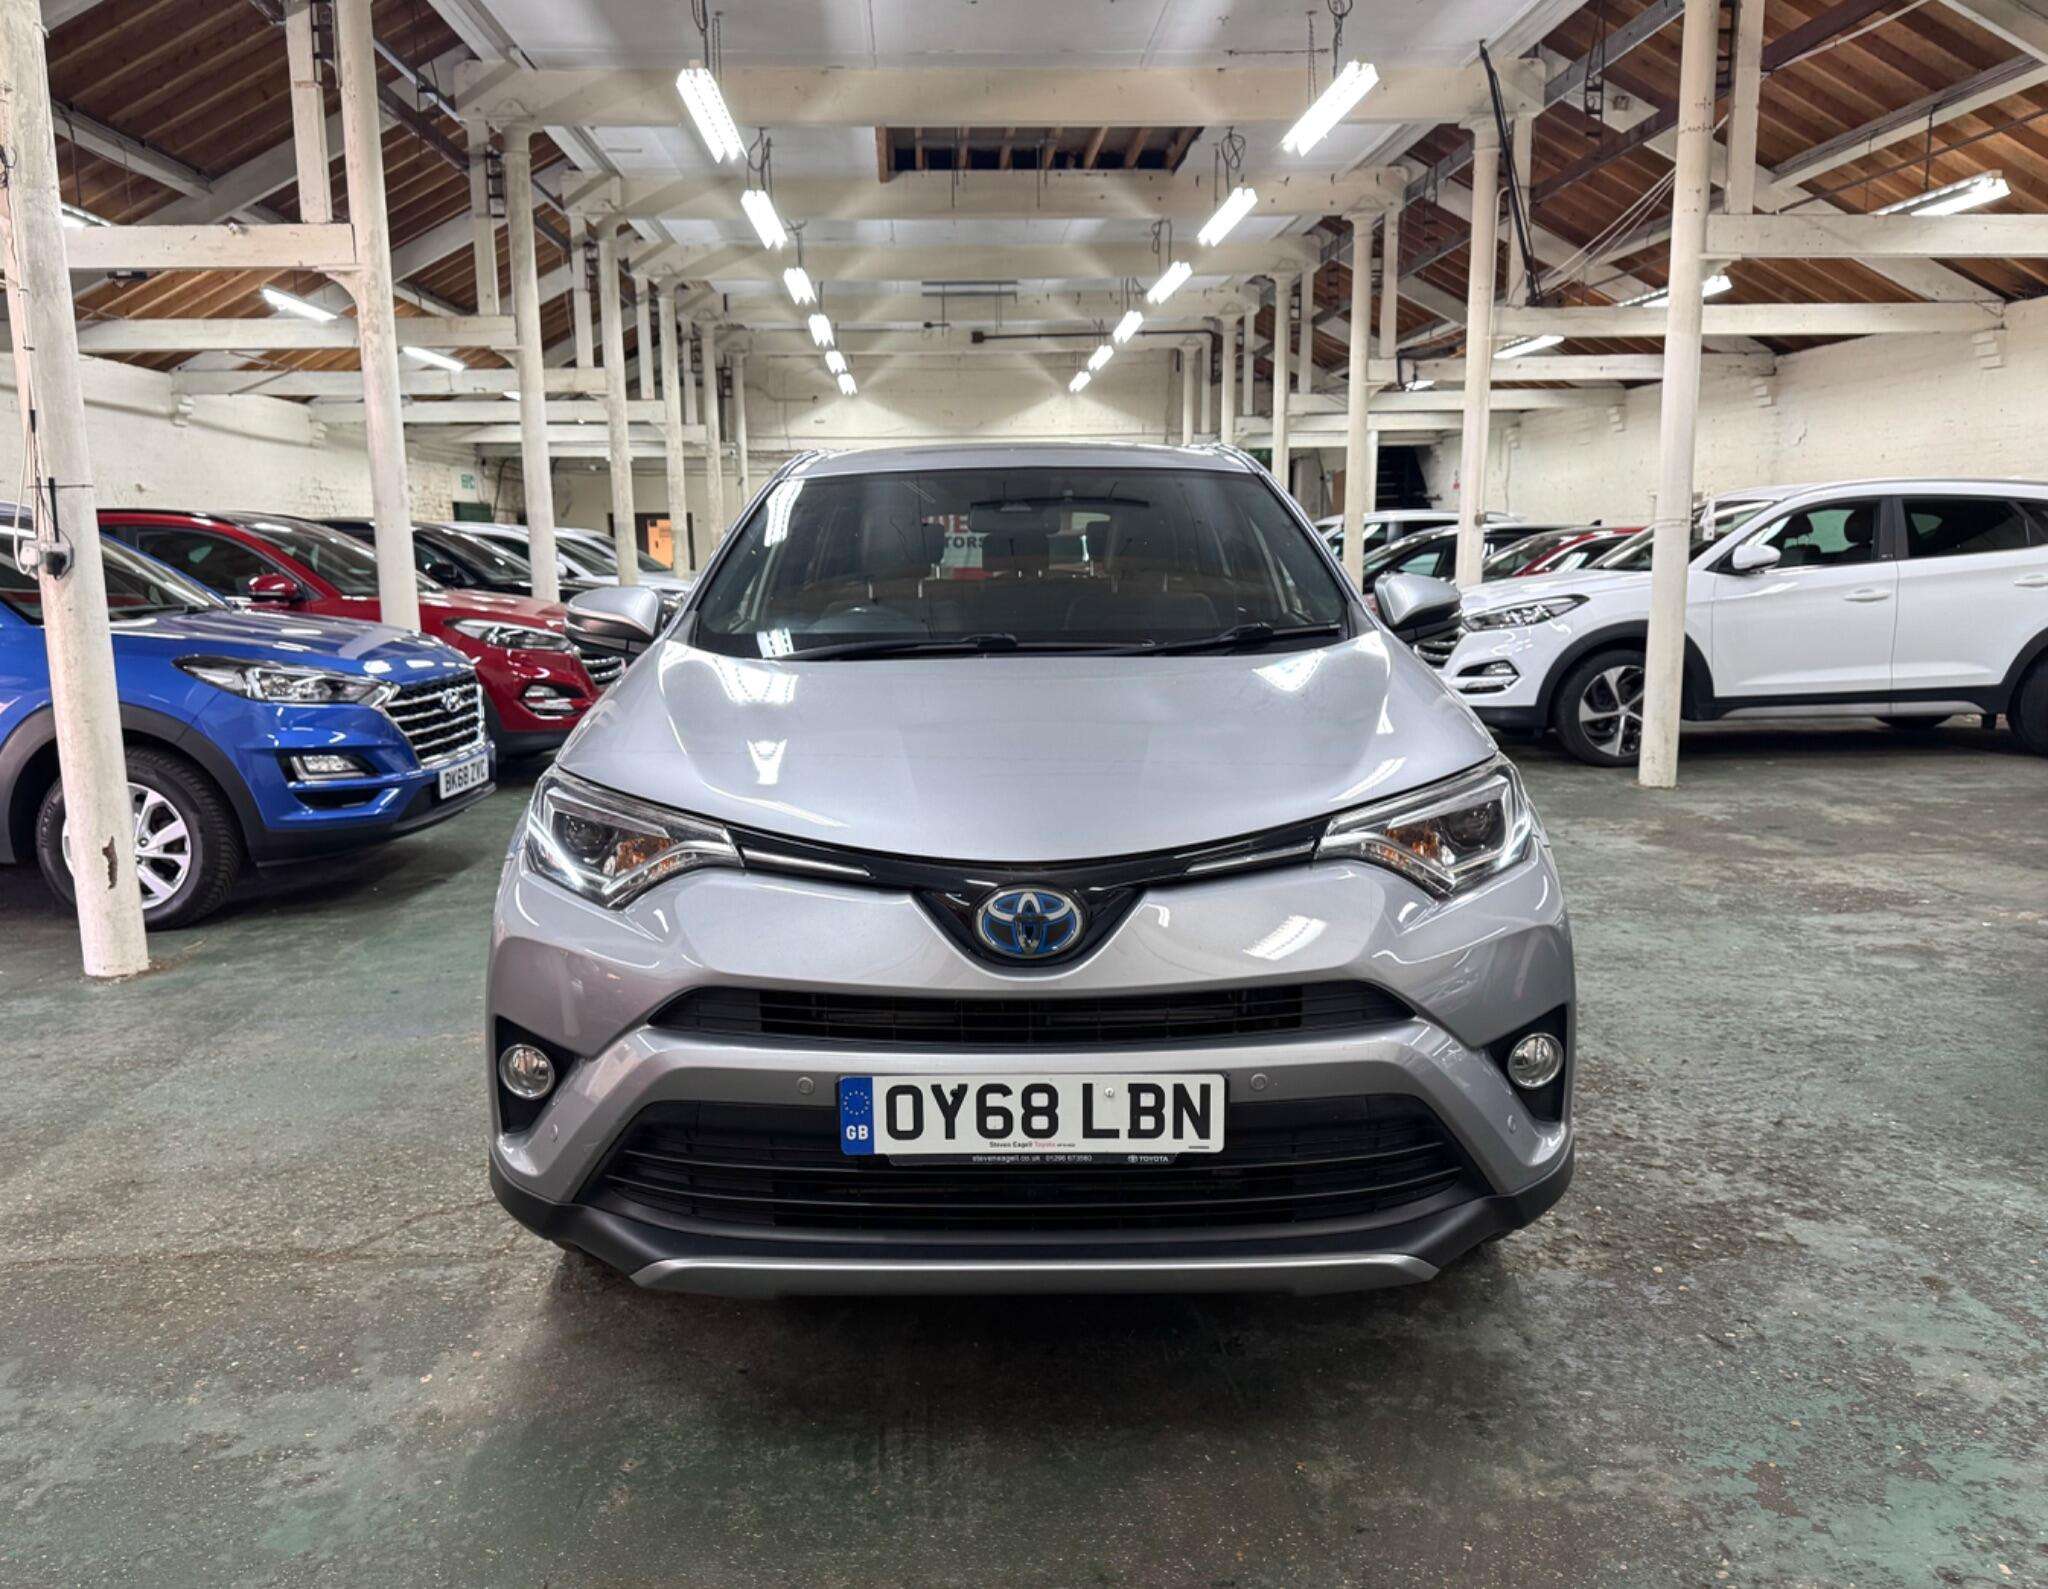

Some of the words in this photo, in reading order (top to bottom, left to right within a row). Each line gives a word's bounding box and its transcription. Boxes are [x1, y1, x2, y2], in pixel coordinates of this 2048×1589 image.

[444, 765, 469, 792] BK68
[886, 1083, 1059, 1140] OY68
[1082, 1083, 1211, 1139] LBN
[846, 1125, 869, 1140] GB
[1034, 1141, 1056, 1149] Toyota
